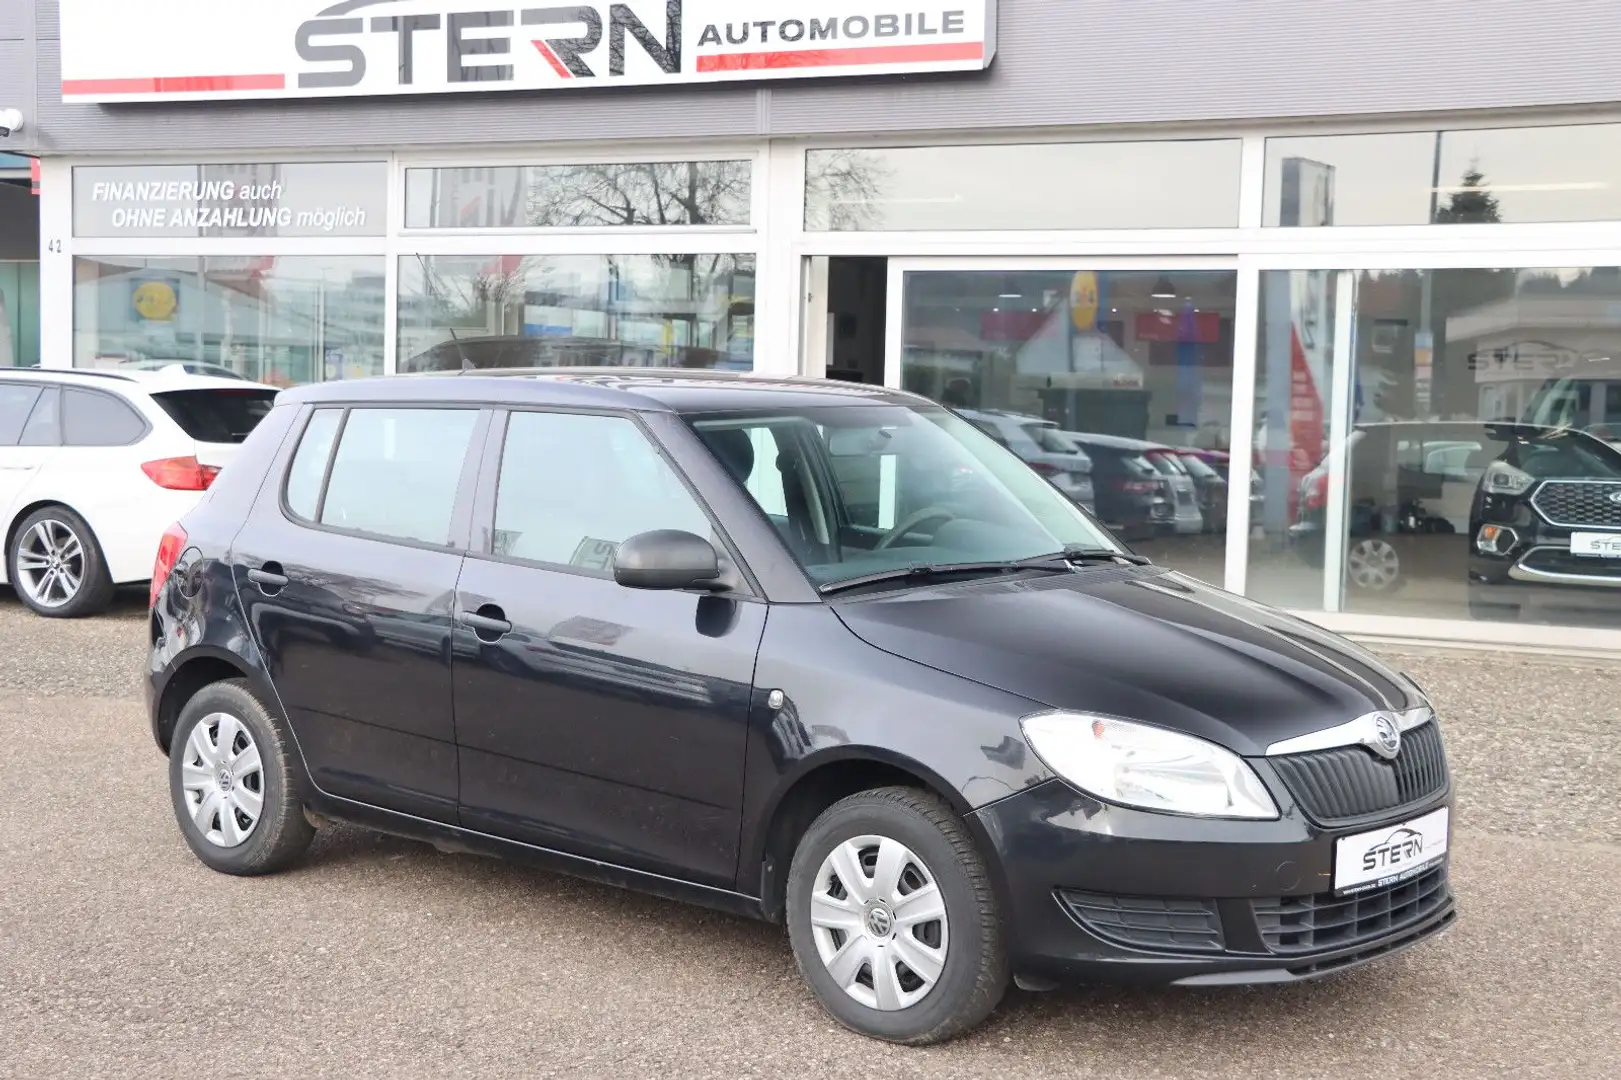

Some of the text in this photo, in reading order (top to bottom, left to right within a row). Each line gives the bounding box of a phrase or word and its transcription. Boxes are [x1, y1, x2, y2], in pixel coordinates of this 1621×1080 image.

[294, 0, 965, 89] STERN AUTOMOBILE
[92, 180, 282, 201] FINANZIERUNG auch
[111, 206, 366, 231] OHNE ANZAHLUNG möglich
[1362, 837, 1423, 871] STERN
